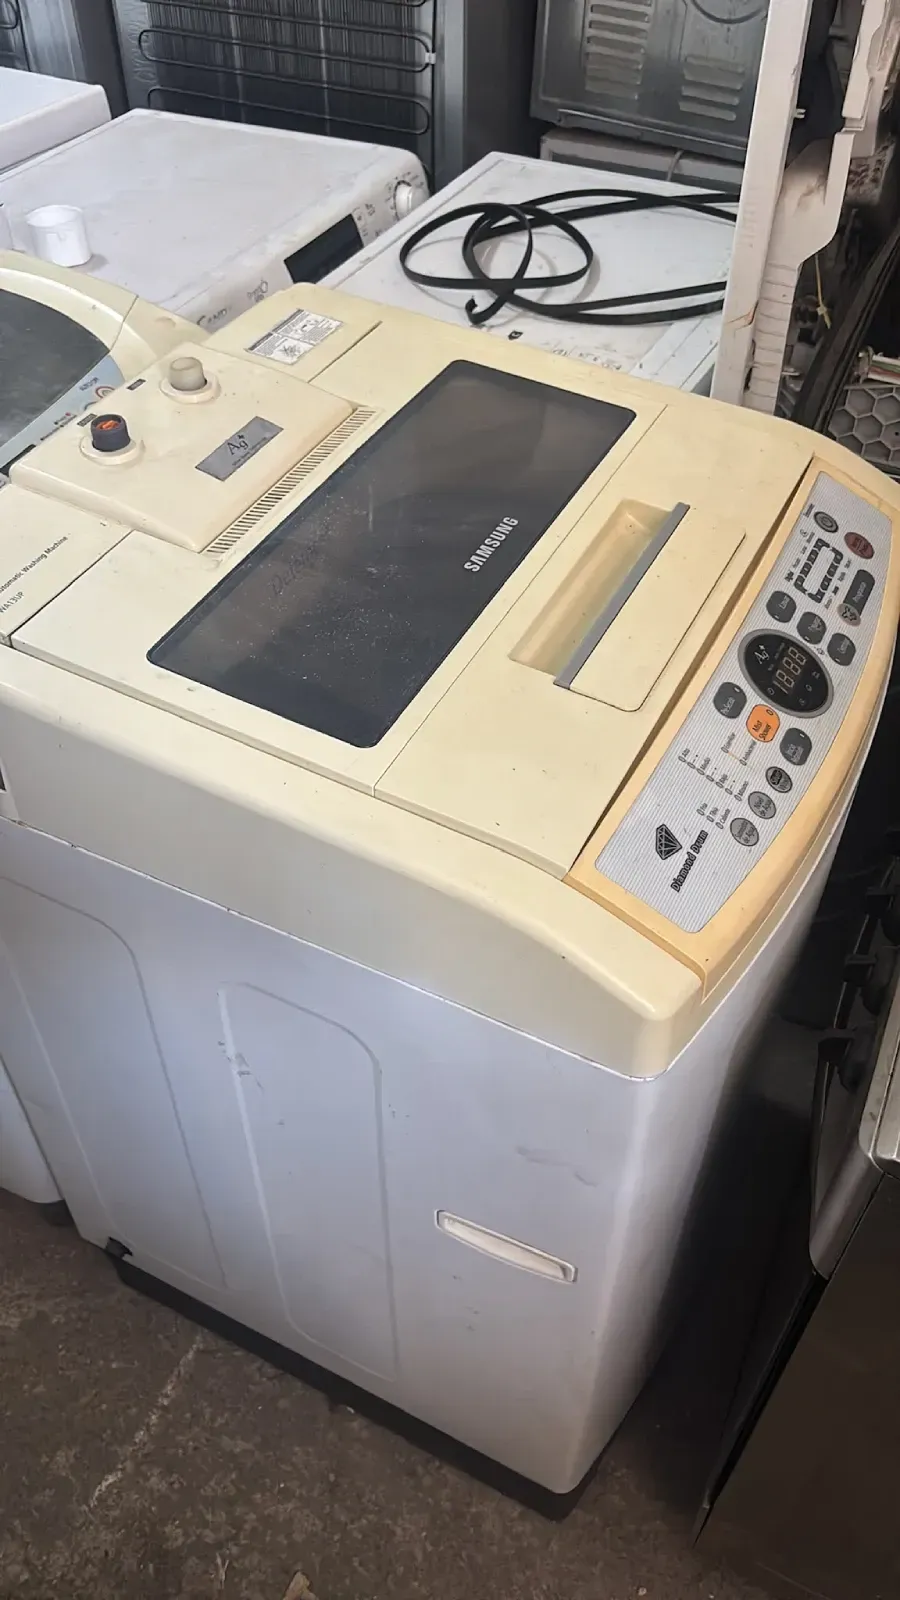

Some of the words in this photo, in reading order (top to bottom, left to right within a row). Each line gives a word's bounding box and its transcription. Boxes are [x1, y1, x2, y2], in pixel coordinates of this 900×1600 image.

[21, 553, 48, 573] Washing
[44, 536, 68, 555] Machine
[463, 516, 519, 572] SAMSUNG
[670, 851, 697, 893] Diamond
[690, 829, 709, 855] Drum
